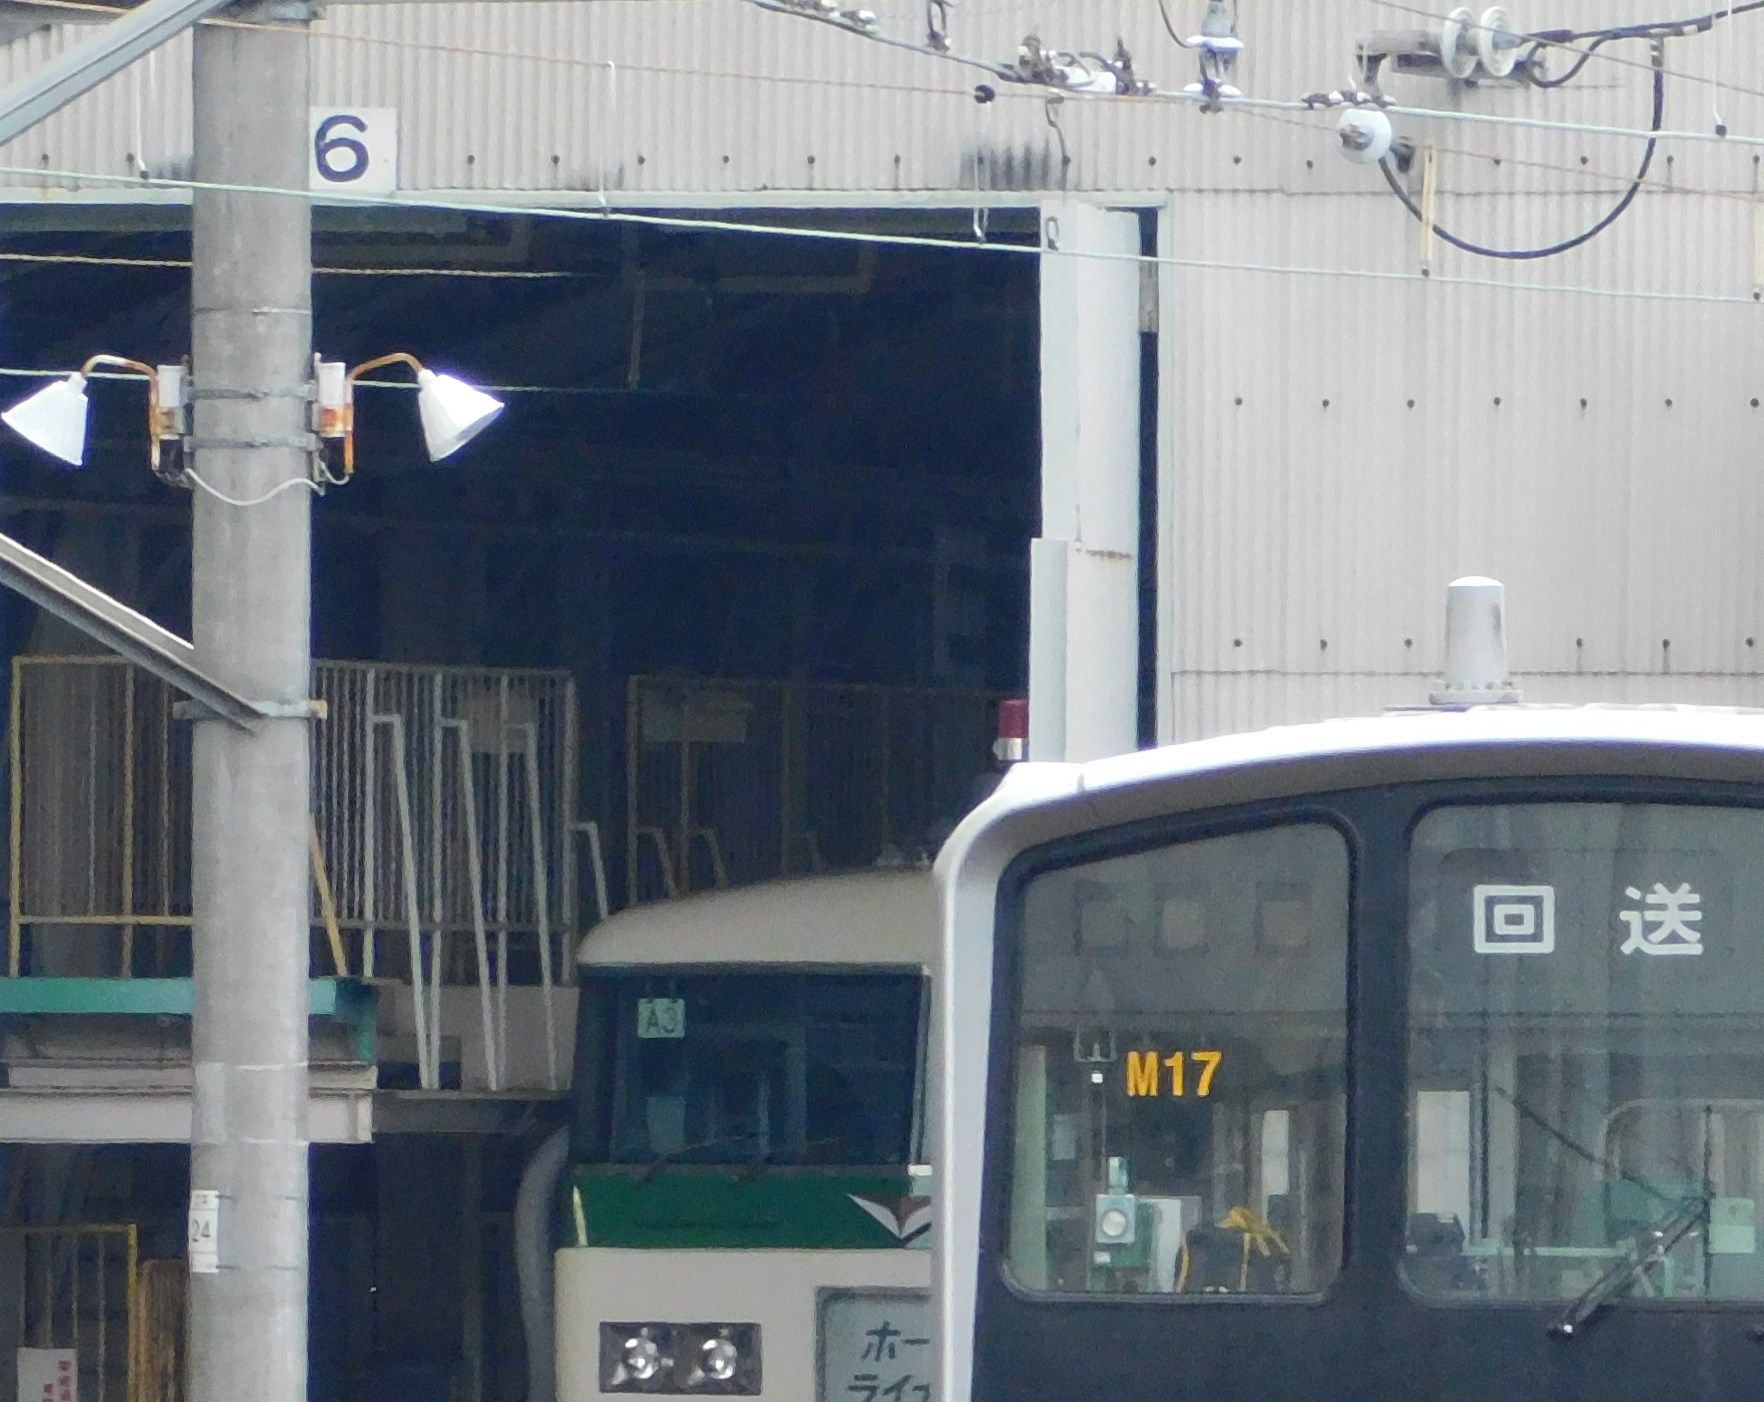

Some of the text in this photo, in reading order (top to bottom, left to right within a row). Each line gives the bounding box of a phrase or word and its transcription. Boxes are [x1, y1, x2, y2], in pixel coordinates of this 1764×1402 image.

[314, 114, 369, 183] 6
[1473, 882, 1704, 956] 回送
[646, 1006, 678, 1034] A3
[1126, 1050, 1223, 1096] M17
